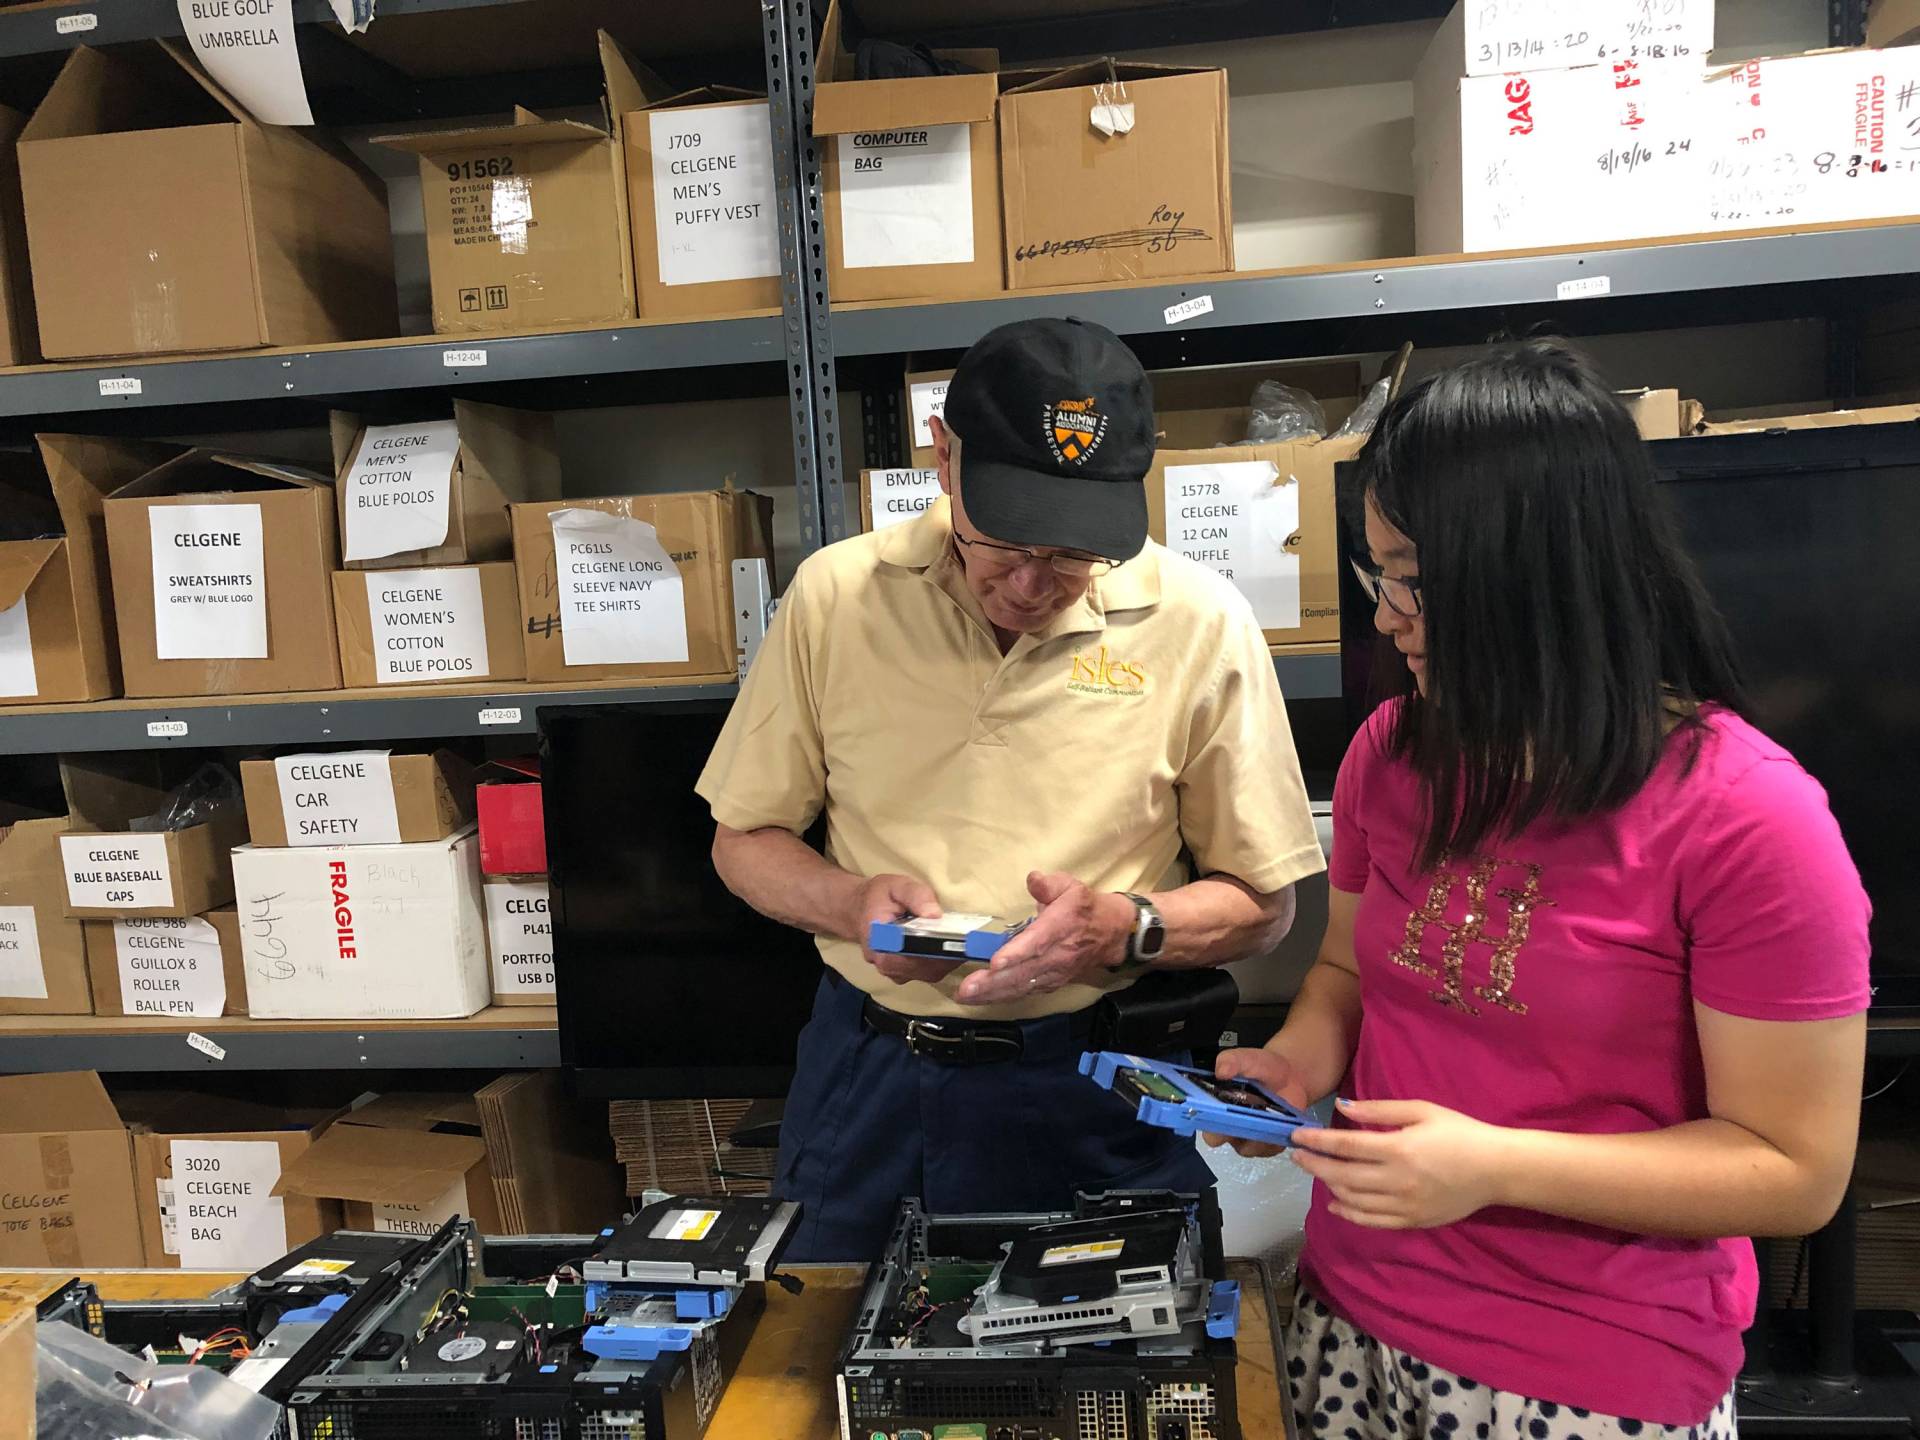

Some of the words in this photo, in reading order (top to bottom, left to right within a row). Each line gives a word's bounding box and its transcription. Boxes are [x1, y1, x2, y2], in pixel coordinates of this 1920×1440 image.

[193, 2, 230, 19] BLUE
[235, 0, 274, 16] GOLF
[200, 28, 279, 49] UMBRELLA
[1564, 31, 1588, 48] 20
[1855, 82, 1868, 148] FRAGILE
[1870, 75, 1885, 153] CAUTION
[668, 133, 702, 150] J709
[853, 131, 928, 147] COMPUTER
[1666, 139, 1691, 155] 24
[448, 156, 513, 181] 91562
[671, 155, 737, 175] CELGENE
[854, 156, 883, 171] BAG
[673, 182, 721, 200] MEN'S
[675, 207, 721, 225] PUFFY
[726, 204, 761, 221] VEST
[454, 236, 477, 245] MADE
[1167, 300, 1206, 320] H-13-04
[446, 352, 481, 364] H-12-04
[1056, 411, 1097, 427] ALUMNI
[373, 435, 429, 450] CELGENE
[366, 454, 408, 467] MEN'S
[359, 471, 412, 486] COTTON
[886, 471, 939, 487] BMUF-
[1181, 484, 1220, 497] 15778
[358, 493, 389, 508] BLUE
[393, 490, 435, 506] POLOS
[887, 497, 938, 513] CELGE
[1181, 505, 1238, 519] CELGENE
[174, 533, 242, 547] CELGENE
[1182, 529, 1197, 541] 12
[1201, 528, 1228, 539] CAN
[570, 543, 612, 555] PC61LS
[571, 561, 625, 574] CELGENE
[629, 560, 663, 572] LONG
[169, 574, 252, 587] SWEATSHIRTS
[573, 580, 615, 594] SLEEVE
[619, 579, 652, 591] NAVY
[170, 595, 192, 604] GREY
[194, 594, 206, 604] W/
[208, 594, 229, 603] BLUE
[231, 594, 253, 603] LOGO
[381, 588, 443, 604] CELGENE
[574, 600, 595, 612] TEE
[598, 599, 641, 612] SHIRTS
[384, 610, 455, 626] WOMEN'S
[387, 636, 444, 650] COTTON
[390, 659, 423, 673] BLUE
[427, 657, 473, 672] POLOS
[482, 710, 517, 721] H-12-03
[151, 724, 183, 733] H-11-03
[290, 763, 366, 781] CELGENE
[295, 793, 329, 808] CAR
[299, 818, 358, 835] SAFETY
[89, 850, 140, 862] CELGENE
[74, 872, 102, 883] BLUE
[105, 870, 162, 883] BASEBALL
[106, 891, 134, 902] CAPS
[328, 861, 356, 959] FRAGILE
[505, 898, 550, 914] CELG
[163, 917, 187, 929] 986
[128, 937, 185, 949] CELGENE
[131, 959, 185, 970] GUILLOX
[188, 959, 197, 970] 8
[133, 979, 180, 991] ROLLER
[518, 973, 542, 983] USB
[135, 1000, 167, 1012] BALL
[169, 1001, 194, 1013] PEN
[185, 1159, 220, 1171] 3020
[187, 1182, 252, 1195] CELGENE
[189, 1205, 237, 1218] BEACH
[191, 1228, 221, 1240] BAG
